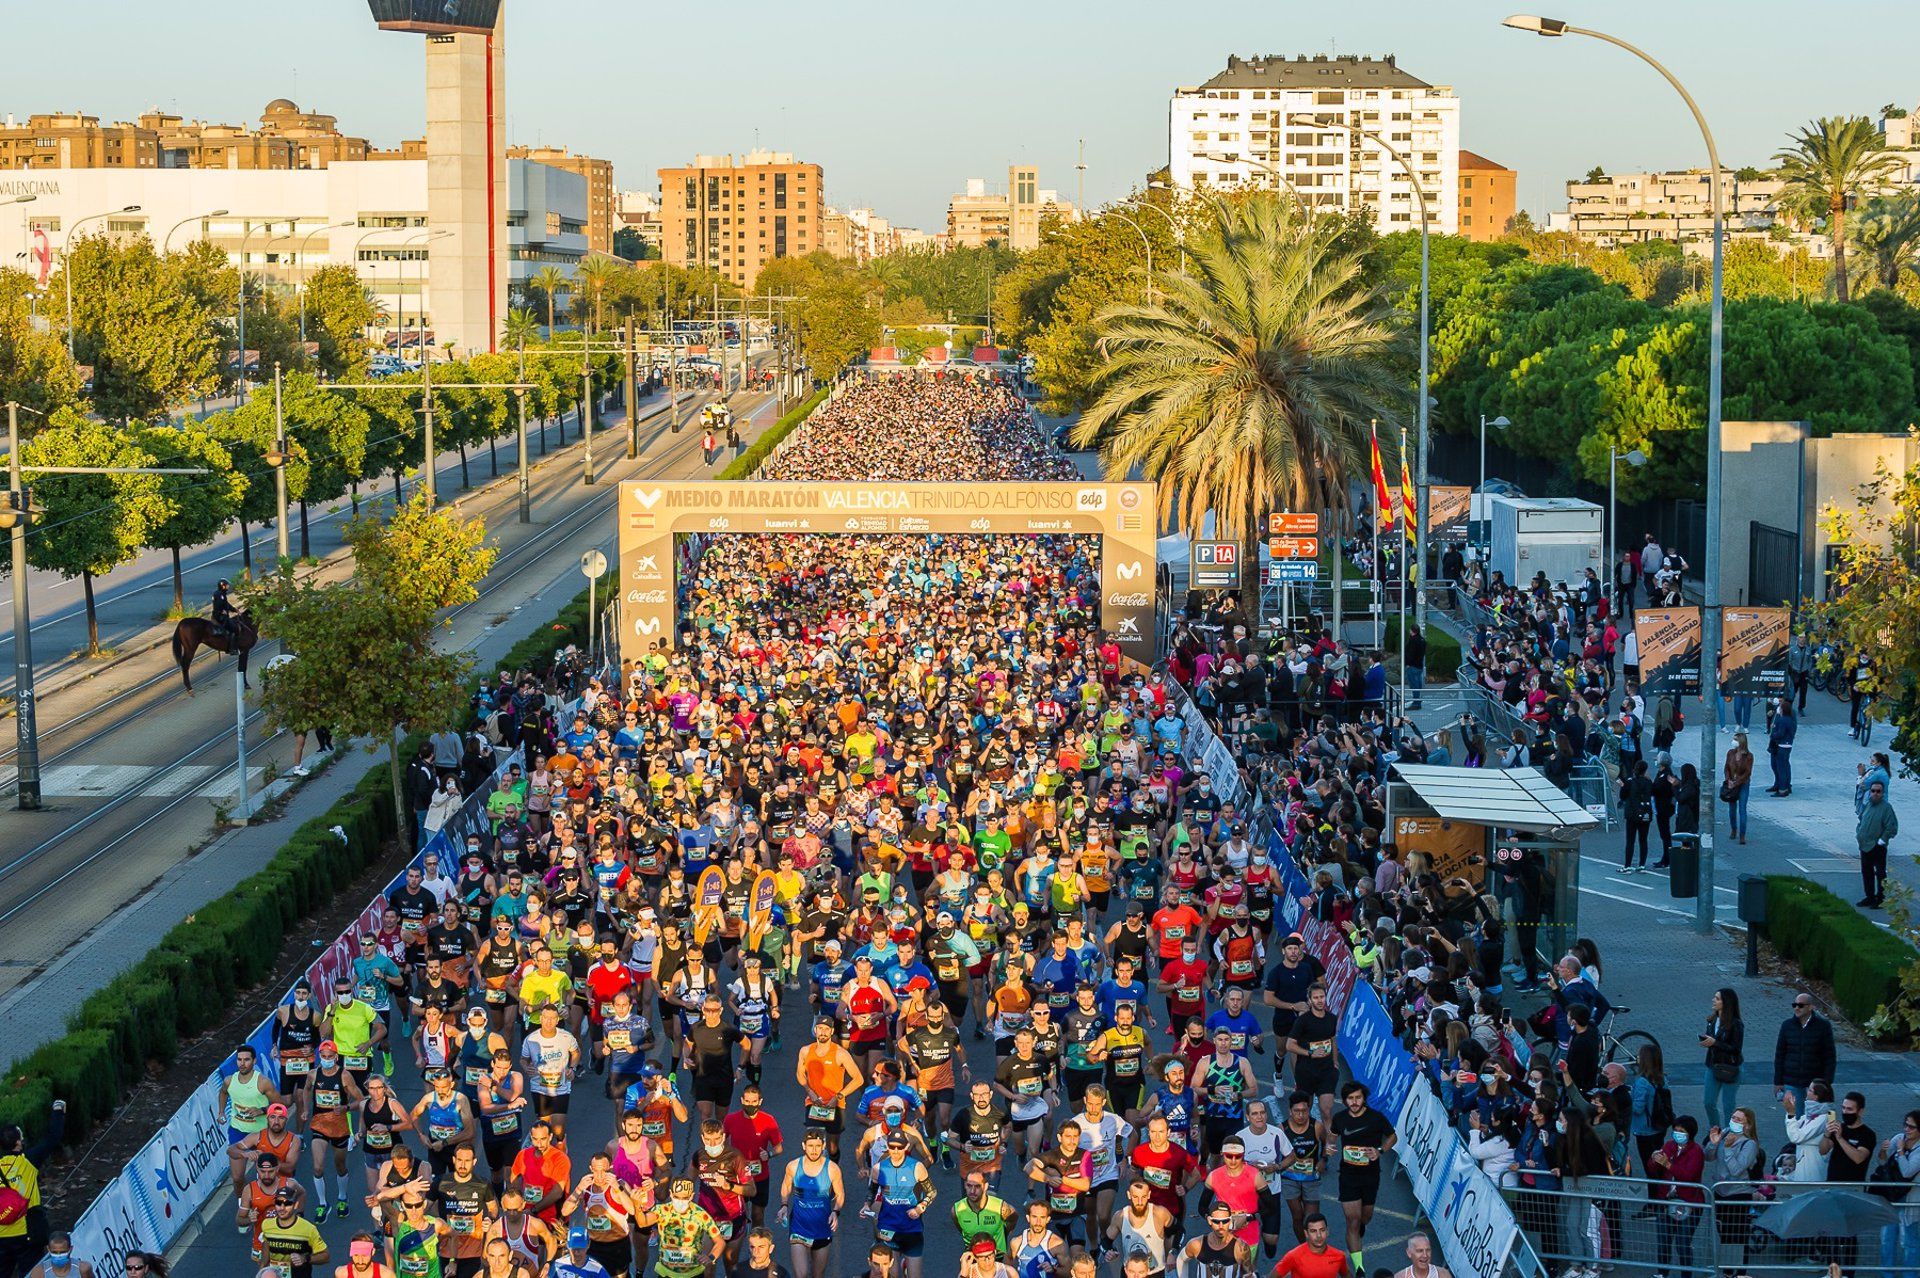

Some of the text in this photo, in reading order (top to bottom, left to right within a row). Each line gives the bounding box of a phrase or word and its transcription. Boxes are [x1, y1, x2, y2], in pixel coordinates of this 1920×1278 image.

[665, 486, 1073, 509] MEDIO MARATÓN VALENCIA TRINIDAD ALFONSO
[1080, 492, 1104, 509] edp
[709, 515, 729, 530] edp
[765, 518, 798, 529] luanvi
[970, 516, 990, 531] edp
[1028, 519, 1060, 529] luanvi
[1201, 547, 1234, 561] P 1A
[1303, 564, 1316, 578] 14
[627, 589, 668, 603] Coca-Cola
[1108, 592, 1150, 607] Coca-Cola
[1638, 615, 1650, 625] 30
[1660, 619, 1699, 646] VELOCIDAD
[1745, 620, 1786, 647] VELOCITAT
[1399, 821, 1418, 835] 30
[705, 881, 720, 891] 1:45
[759, 885, 774, 896] 1:45
[1452, 1189, 1502, 1278] CaixaBan
[92, 1205, 144, 1278] ixaBank
